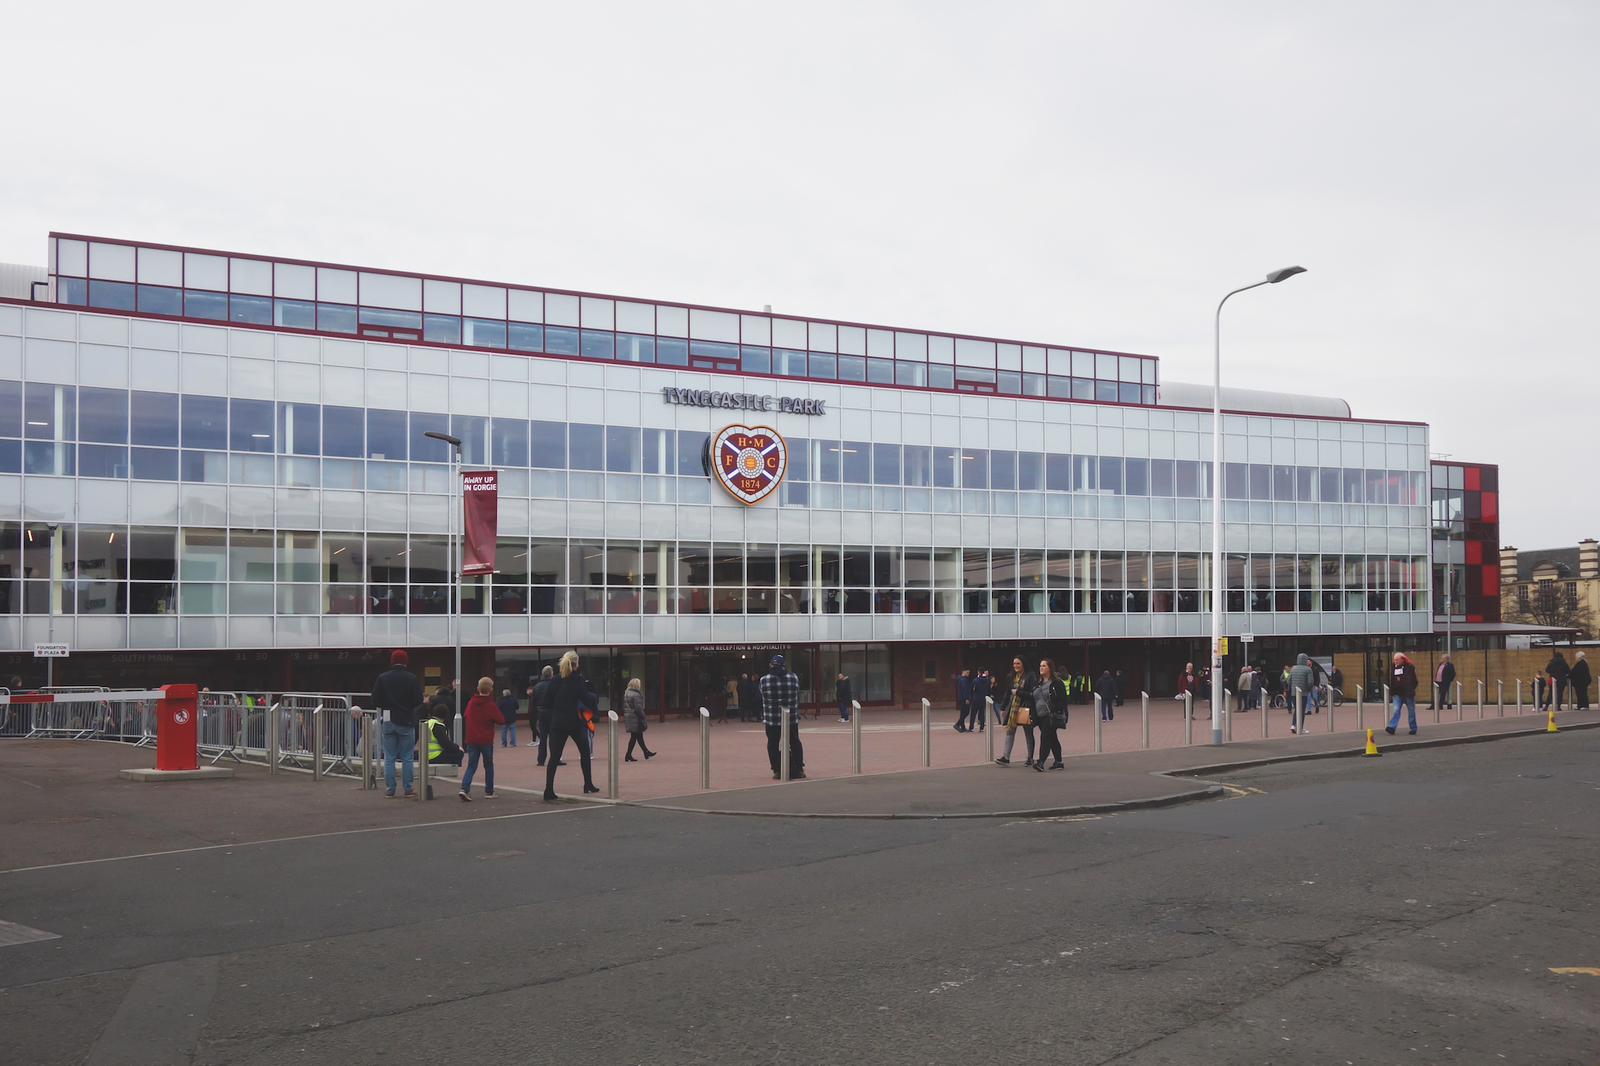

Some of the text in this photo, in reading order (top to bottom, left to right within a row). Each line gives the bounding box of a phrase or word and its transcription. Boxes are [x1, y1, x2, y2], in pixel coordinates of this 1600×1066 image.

[663, 386, 826, 416] TYNECASTLE PARK
[725, 455, 733, 466] F
[766, 457, 776, 468] C
[741, 479, 761, 488] 1874
[111, 653, 174, 662] SOUTH MAIN
[235, 652, 268, 661] 31 30
[307, 651, 320, 660] 28
[338, 651, 350, 660] 27
